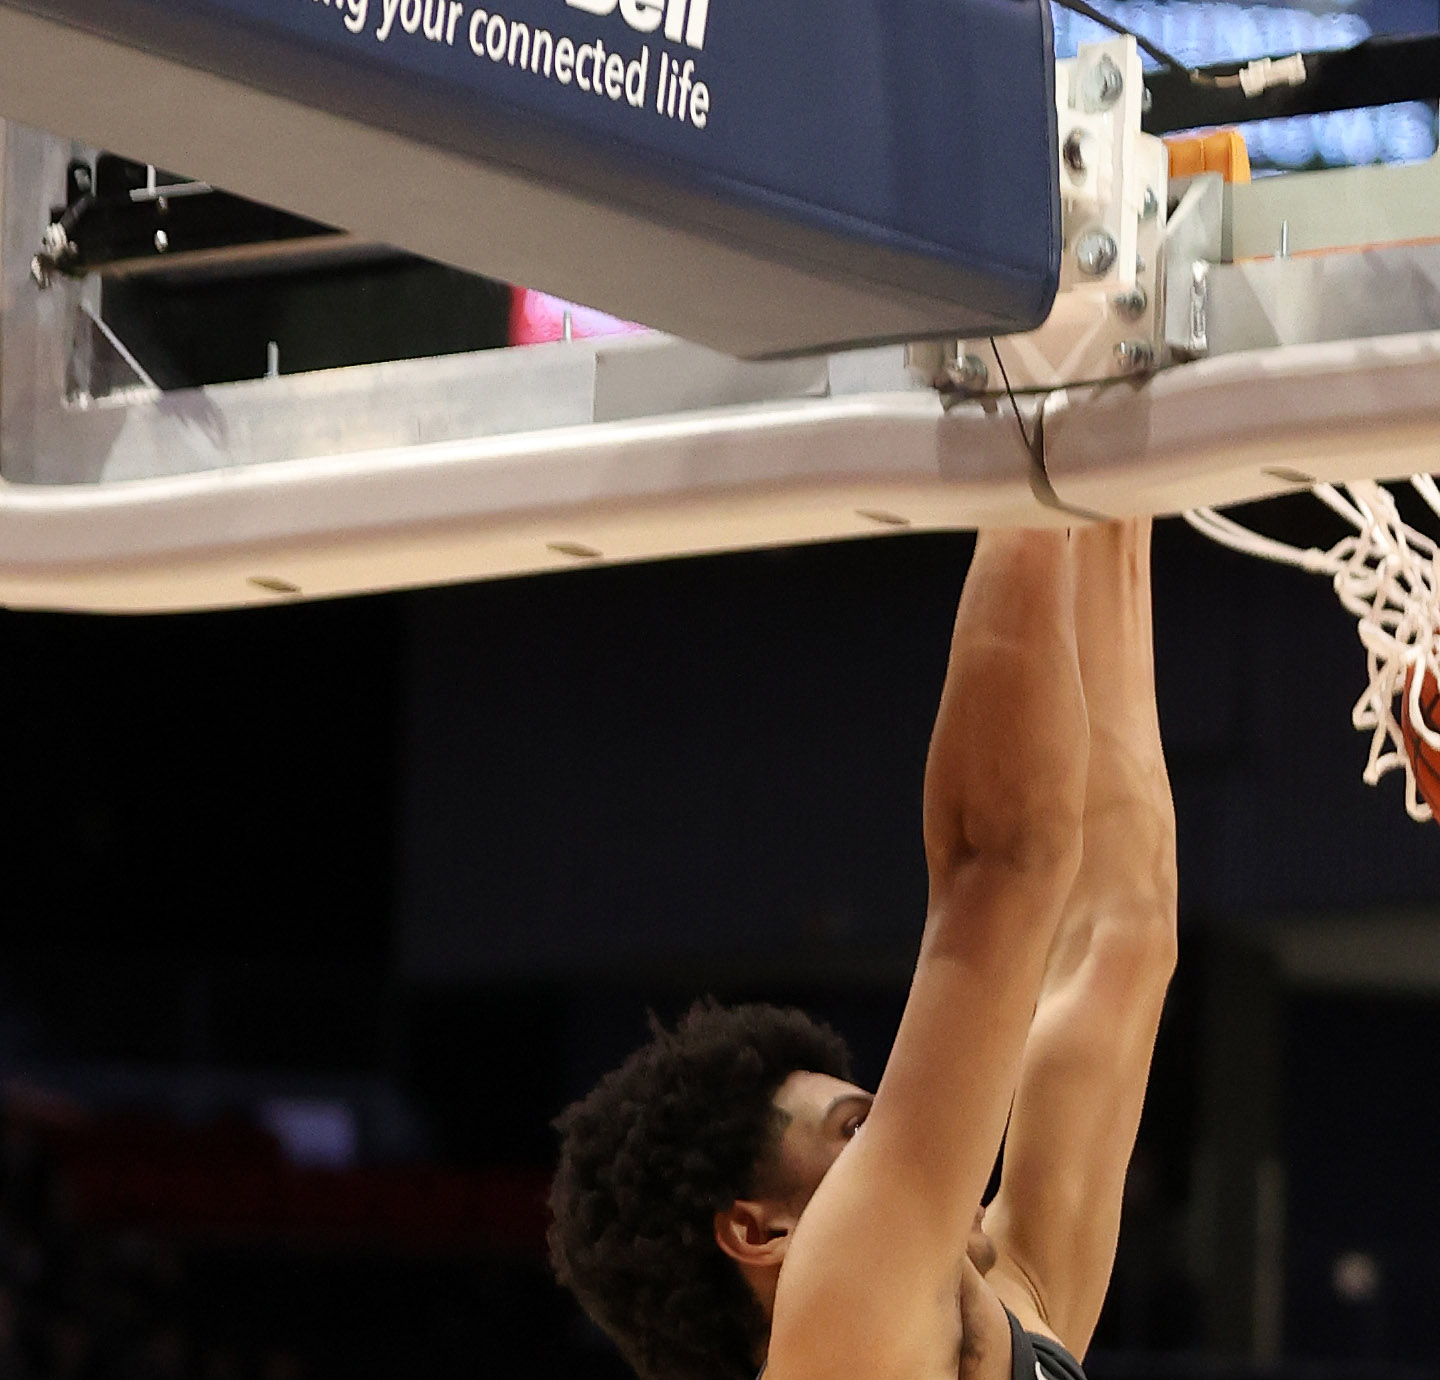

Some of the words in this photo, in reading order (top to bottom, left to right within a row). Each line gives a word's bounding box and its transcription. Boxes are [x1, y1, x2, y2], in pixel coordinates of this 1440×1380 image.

[376, 0, 463, 46] your
[469, 8, 649, 108] connected
[656, 51, 710, 129] life
[564, 0, 709, 50] ell
